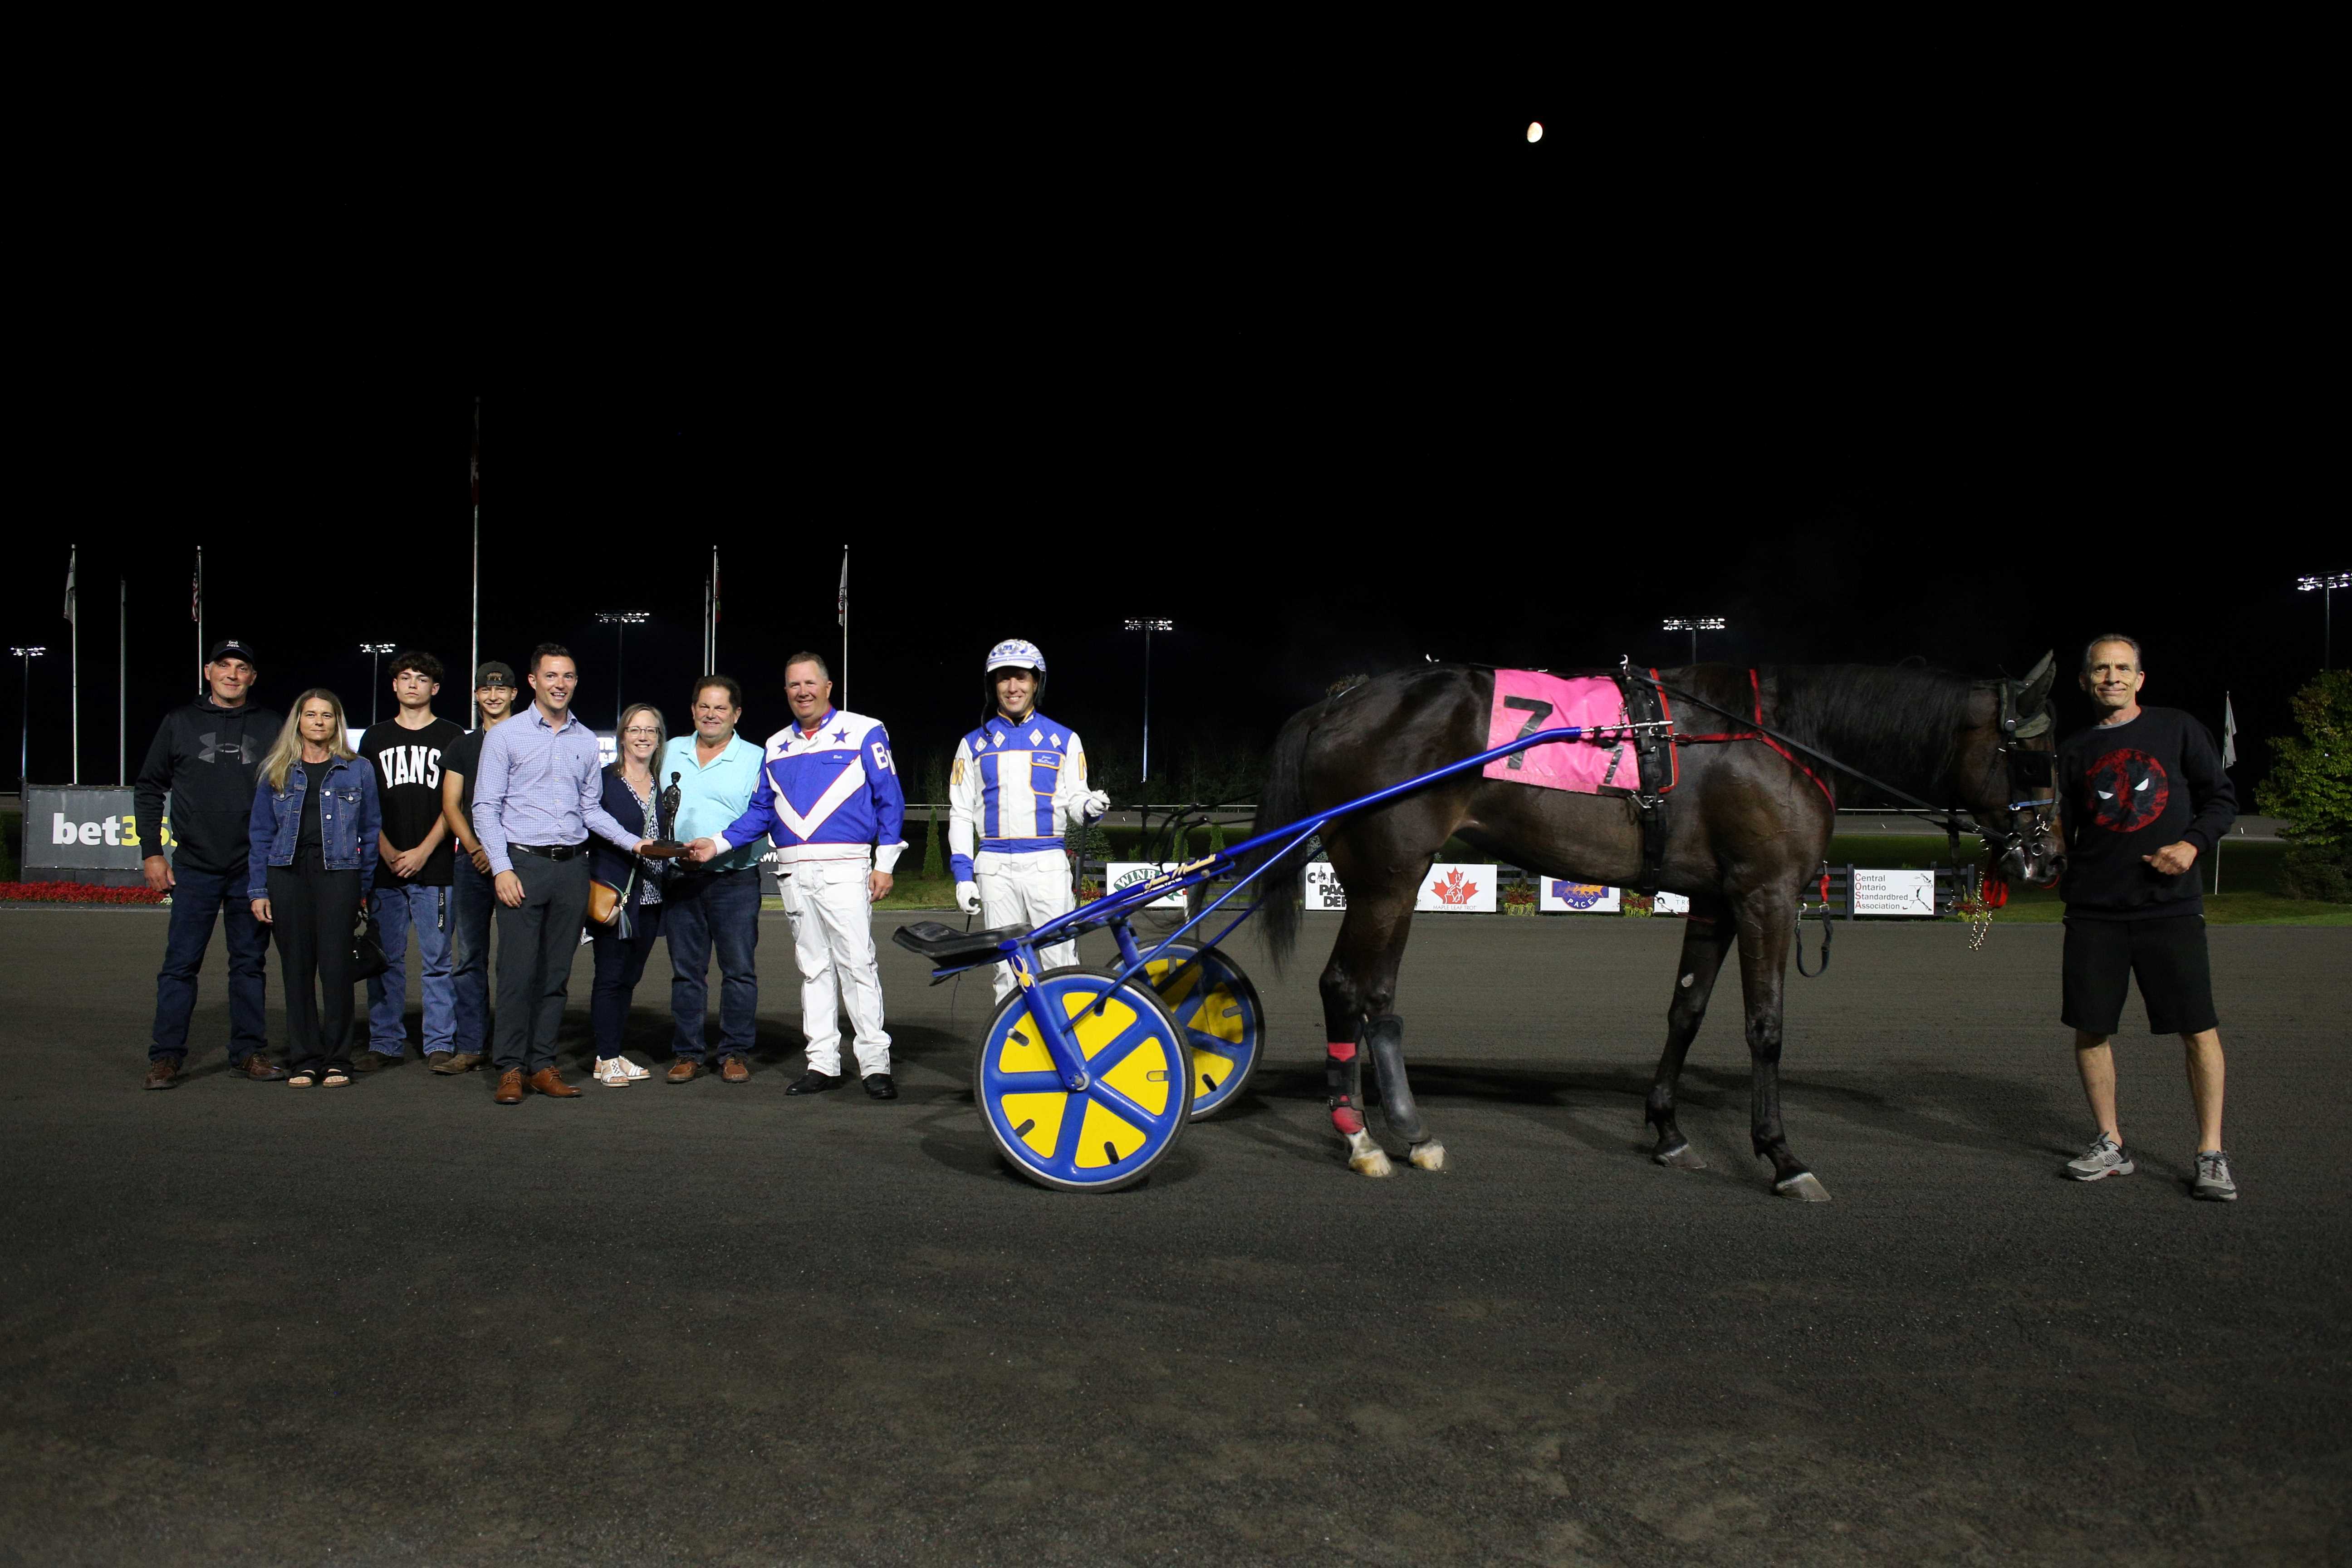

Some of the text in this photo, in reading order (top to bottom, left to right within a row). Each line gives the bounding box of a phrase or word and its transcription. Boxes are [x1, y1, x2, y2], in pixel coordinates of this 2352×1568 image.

[1504, 696, 1553, 770] 7
[379, 745, 441, 789] VANS
[1115, 869, 1162, 890] WINB
[1855, 873, 1886, 882] Central
[1855, 882, 1886, 891] Ontario
[1855, 891, 1908, 901] Standardbred
[1855, 900, 1900, 910] Association
